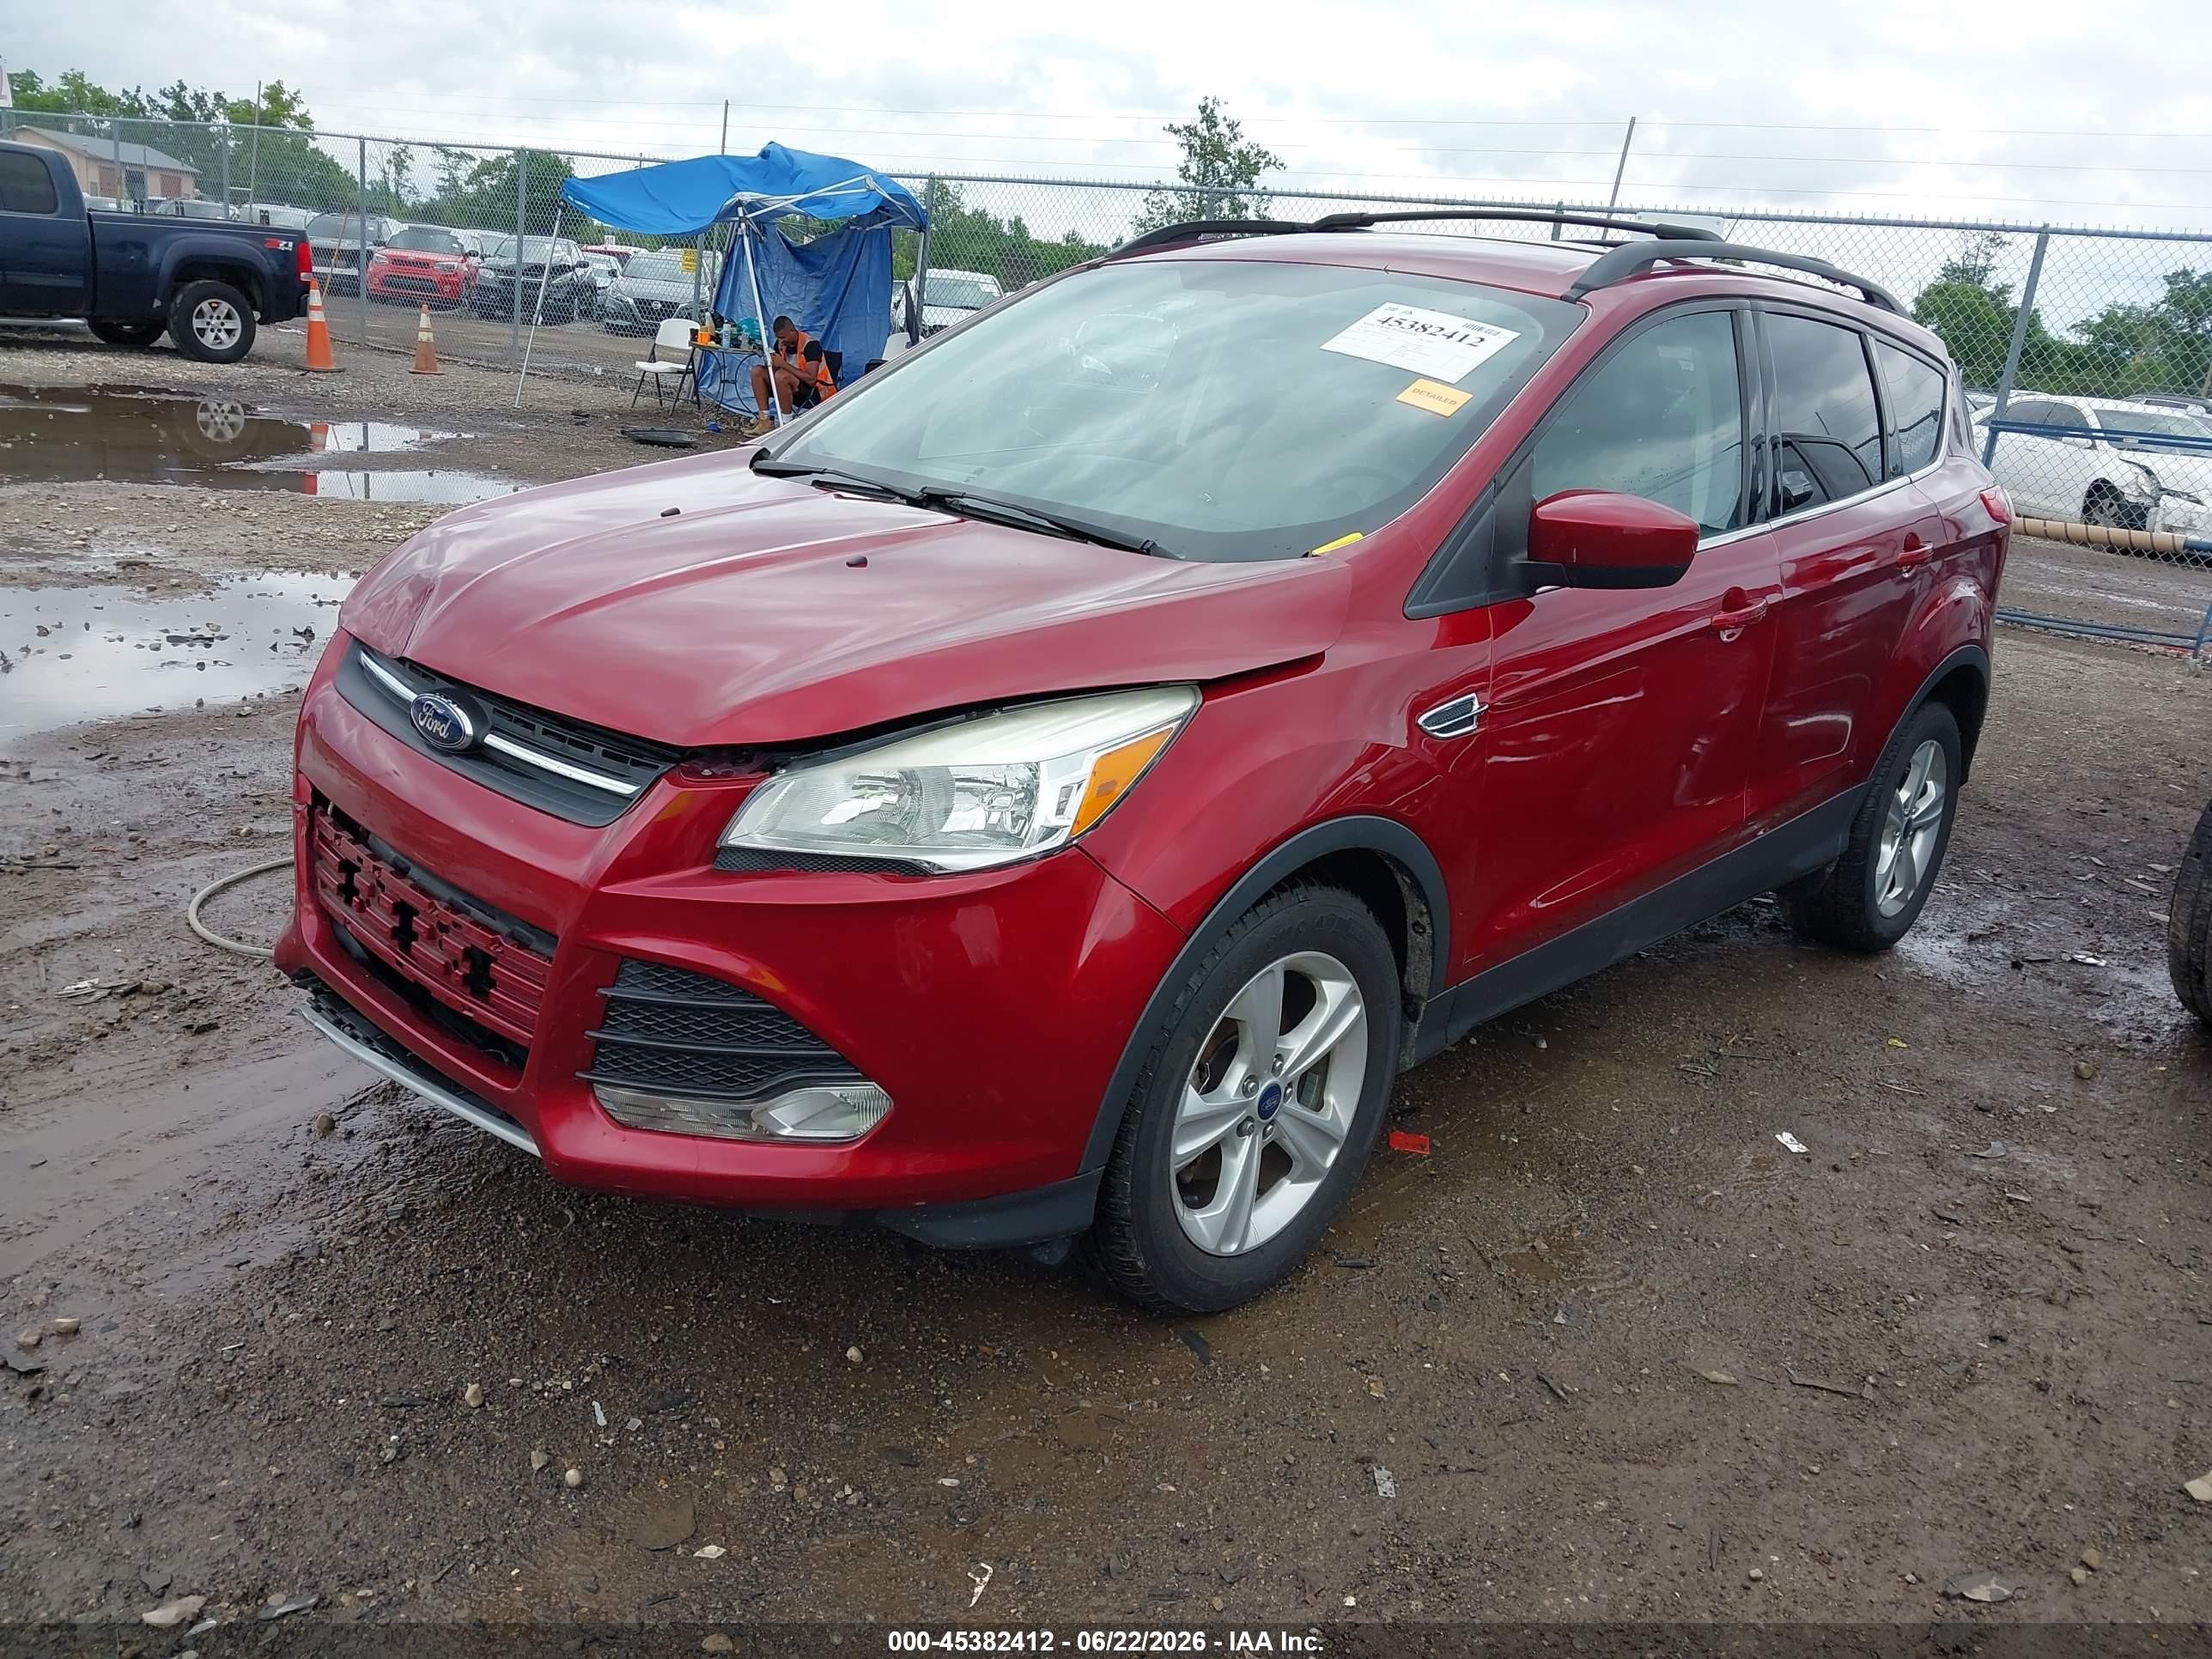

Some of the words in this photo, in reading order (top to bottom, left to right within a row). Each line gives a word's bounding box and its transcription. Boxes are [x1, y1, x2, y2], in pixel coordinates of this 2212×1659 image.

[1376, 315, 1486, 348] 45382412
[1411, 387, 1458, 406] DETAILED
[417, 700, 452, 740] Ford
